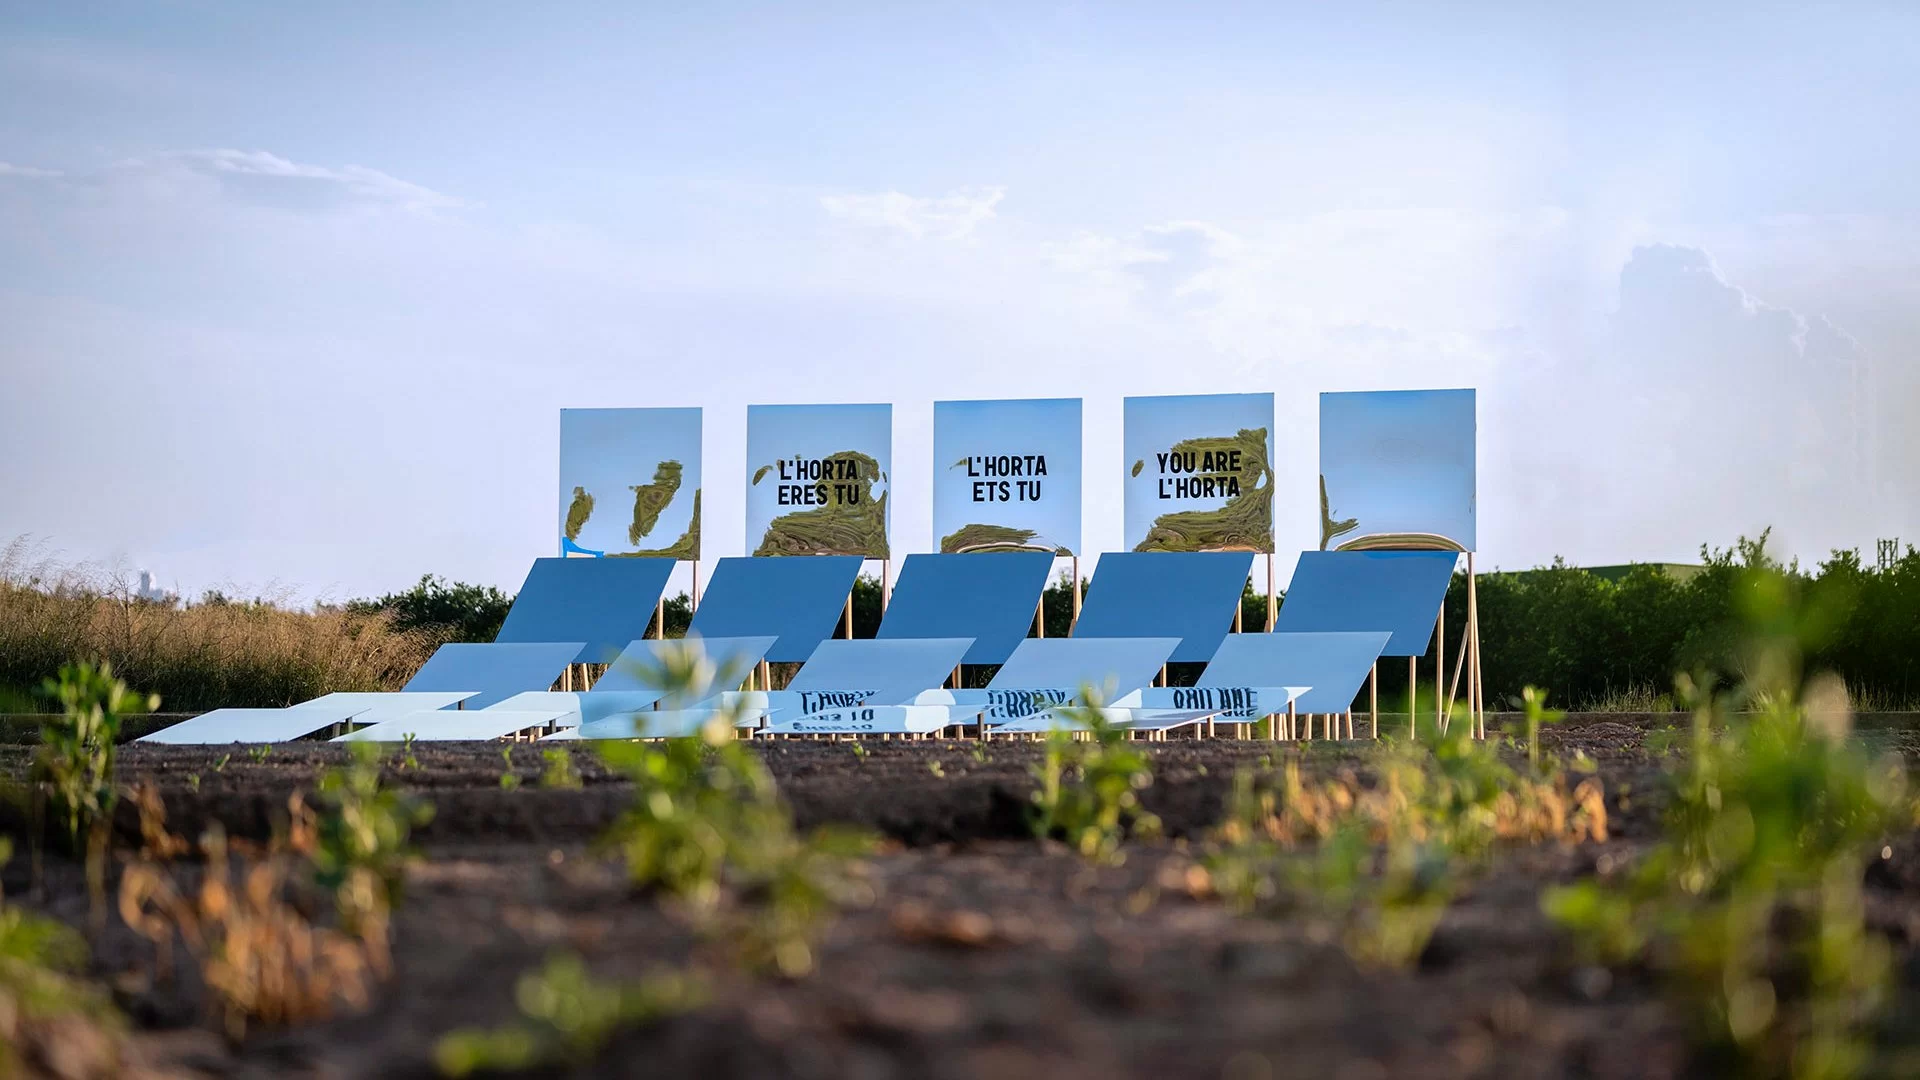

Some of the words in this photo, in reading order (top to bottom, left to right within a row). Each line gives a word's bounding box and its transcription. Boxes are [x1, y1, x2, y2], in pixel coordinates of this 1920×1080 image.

[780, 460, 858, 480] L'HORTA
[967, 455, 1047, 476] L'HORTA
[1156, 451, 1196, 474] YOU
[1202, 450, 1242, 473] ARE
[778, 484, 828, 505] ERES
[834, 484, 860, 505] TU
[973, 481, 1010, 501] ETS
[1016, 480, 1041, 501] TU
[1159, 476, 1241, 499] L'HORTA
